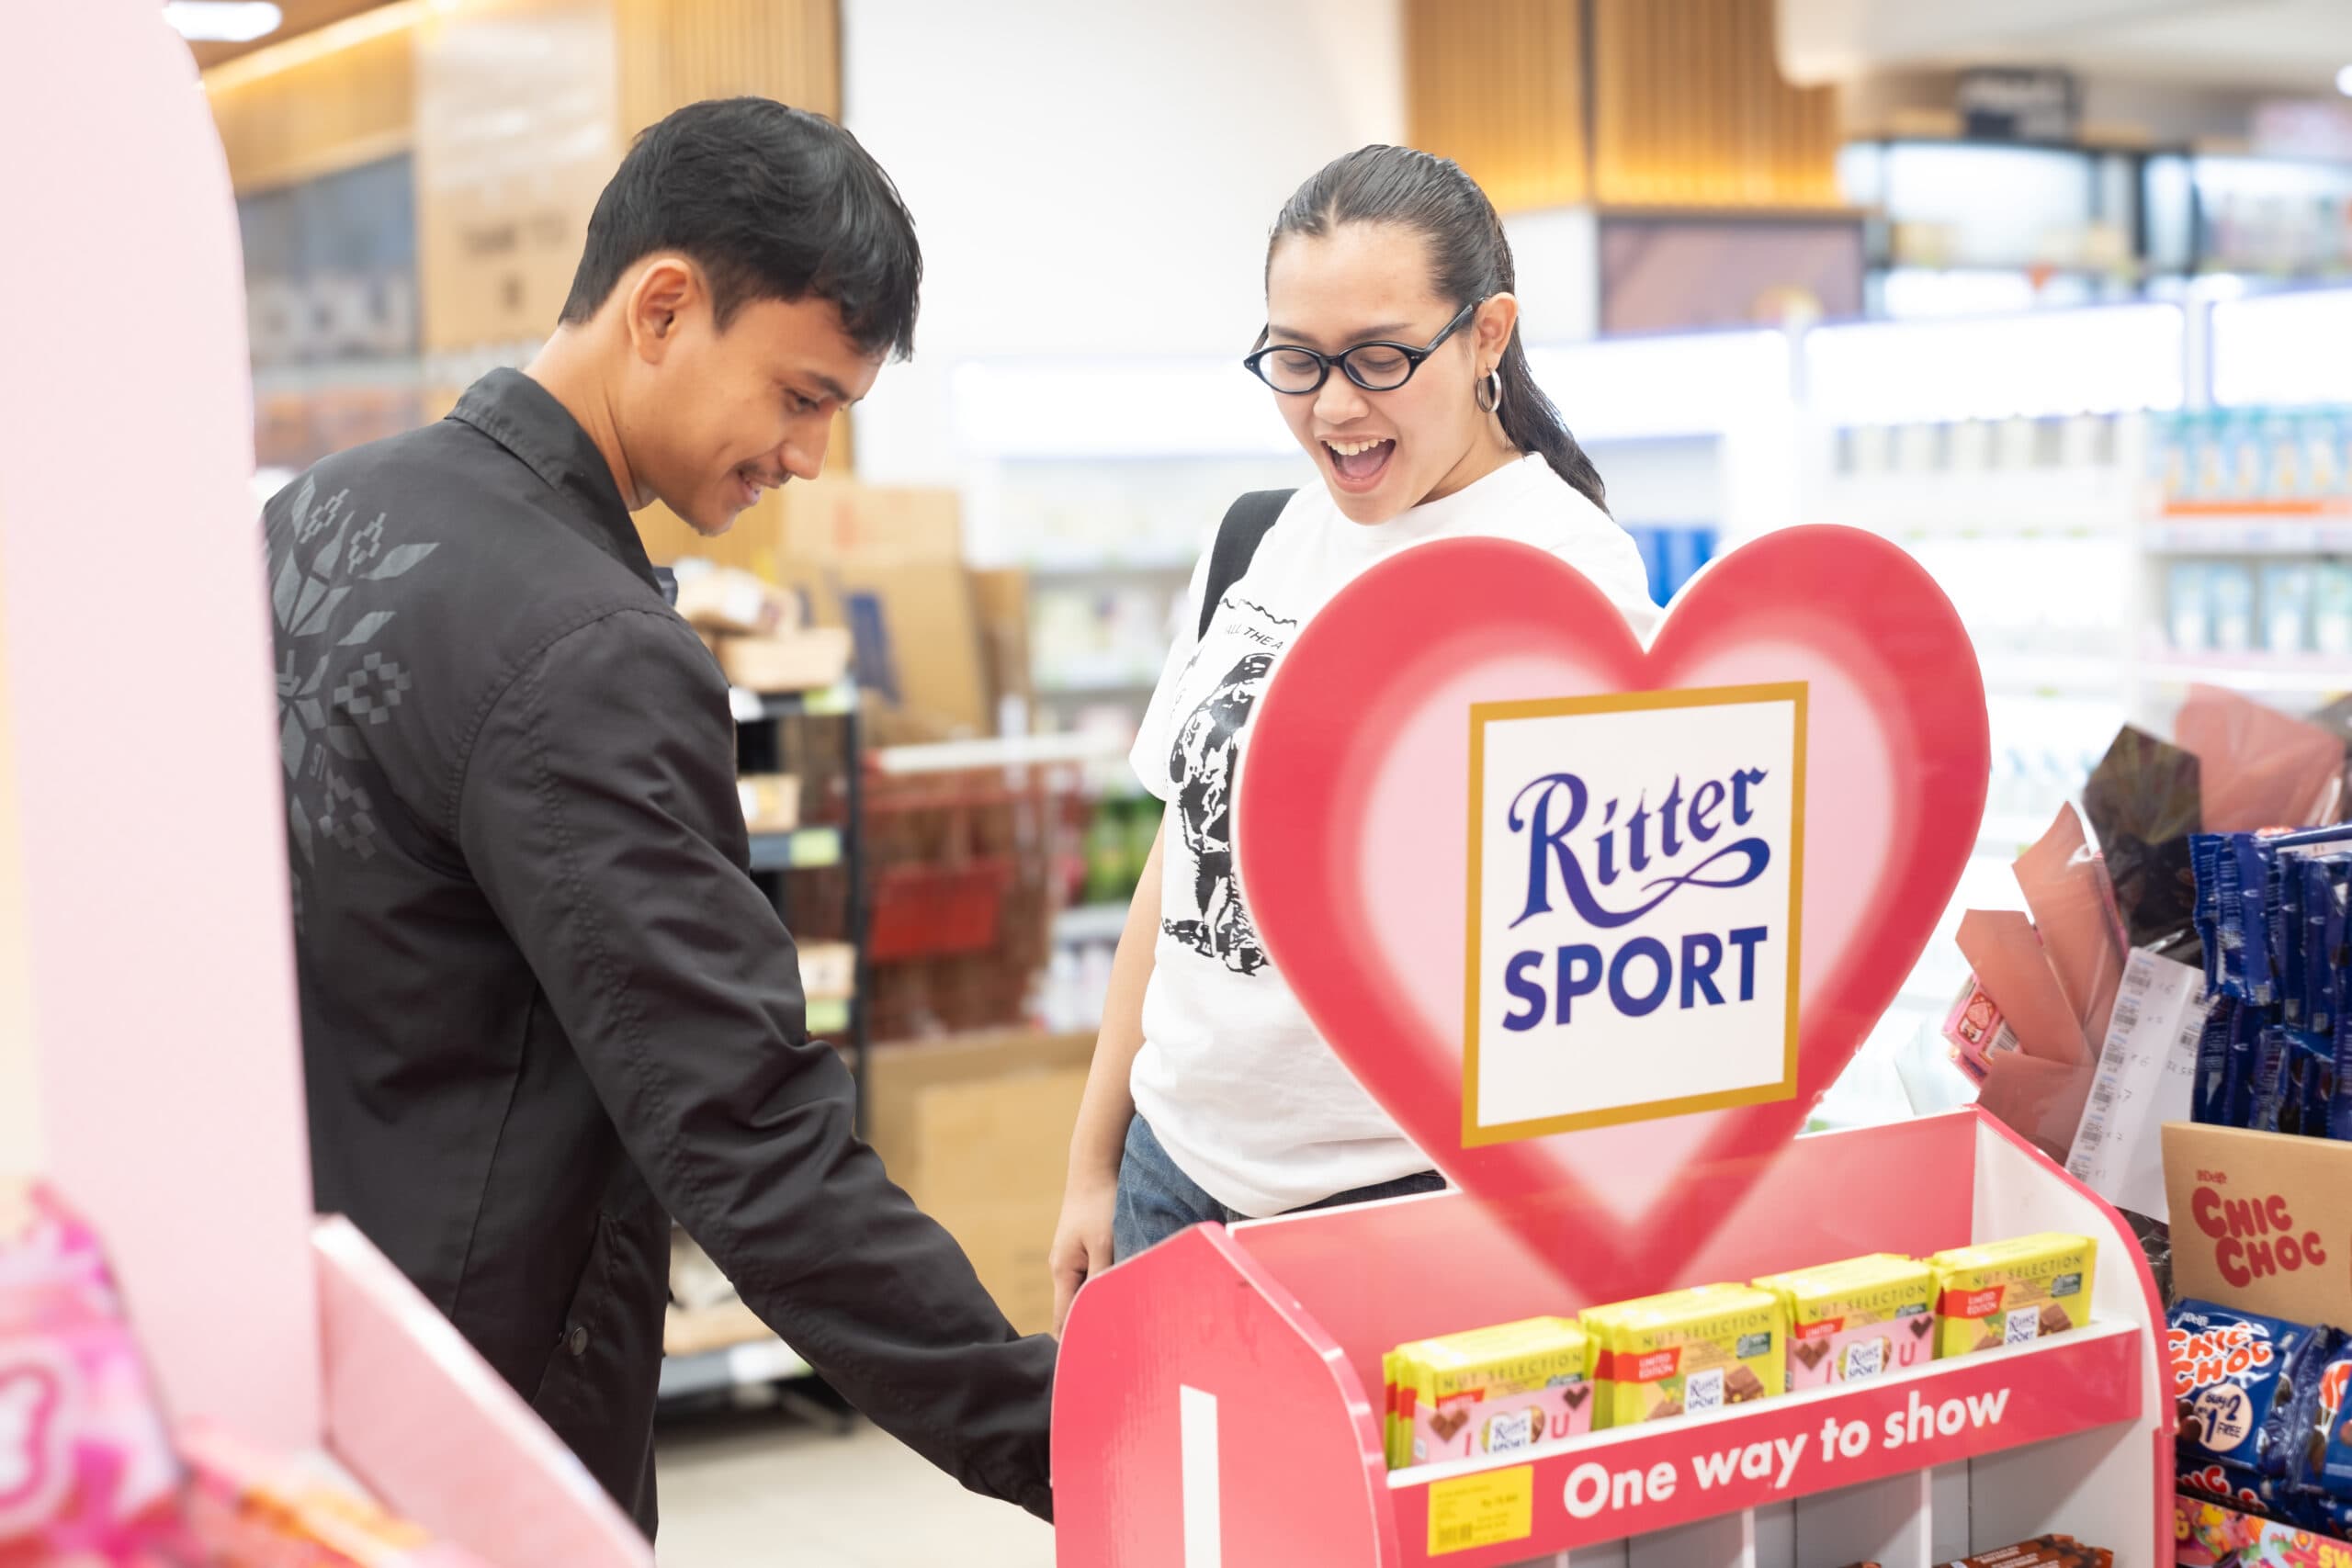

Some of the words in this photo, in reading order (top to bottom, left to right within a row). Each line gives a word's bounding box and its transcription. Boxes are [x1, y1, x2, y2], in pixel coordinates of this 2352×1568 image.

[1243, 626, 1274, 646] THE
[1508, 767, 1770, 930] Ritter
[1501, 925, 1768, 1032] SPORT
[2191, 1186, 2293, 1239] CHIC
[1973, 1271, 2000, 1286] NUT
[2007, 1256, 2082, 1280] SELECTION
[2215, 1231, 2327, 1288] CHOC
[1809, 1303, 1838, 1319] NUT
[1846, 1284, 1928, 1310] SELECTION
[1643, 1332, 1675, 1348] NUT
[1683, 1314, 1770, 1339] SELECTION
[1898, 1341, 1917, 1367] U
[1443, 1373, 1478, 1391] NUT
[1487, 1353, 1583, 1382] SELECTION
[2225, 1394, 2241, 1421] 2
[1551, 1414, 1570, 1439] U
[1563, 1461, 1677, 1519] One
[1692, 1432, 1808, 1490] way
[1819, 1417, 1871, 1462] to
[1883, 1389, 2010, 1449] show
